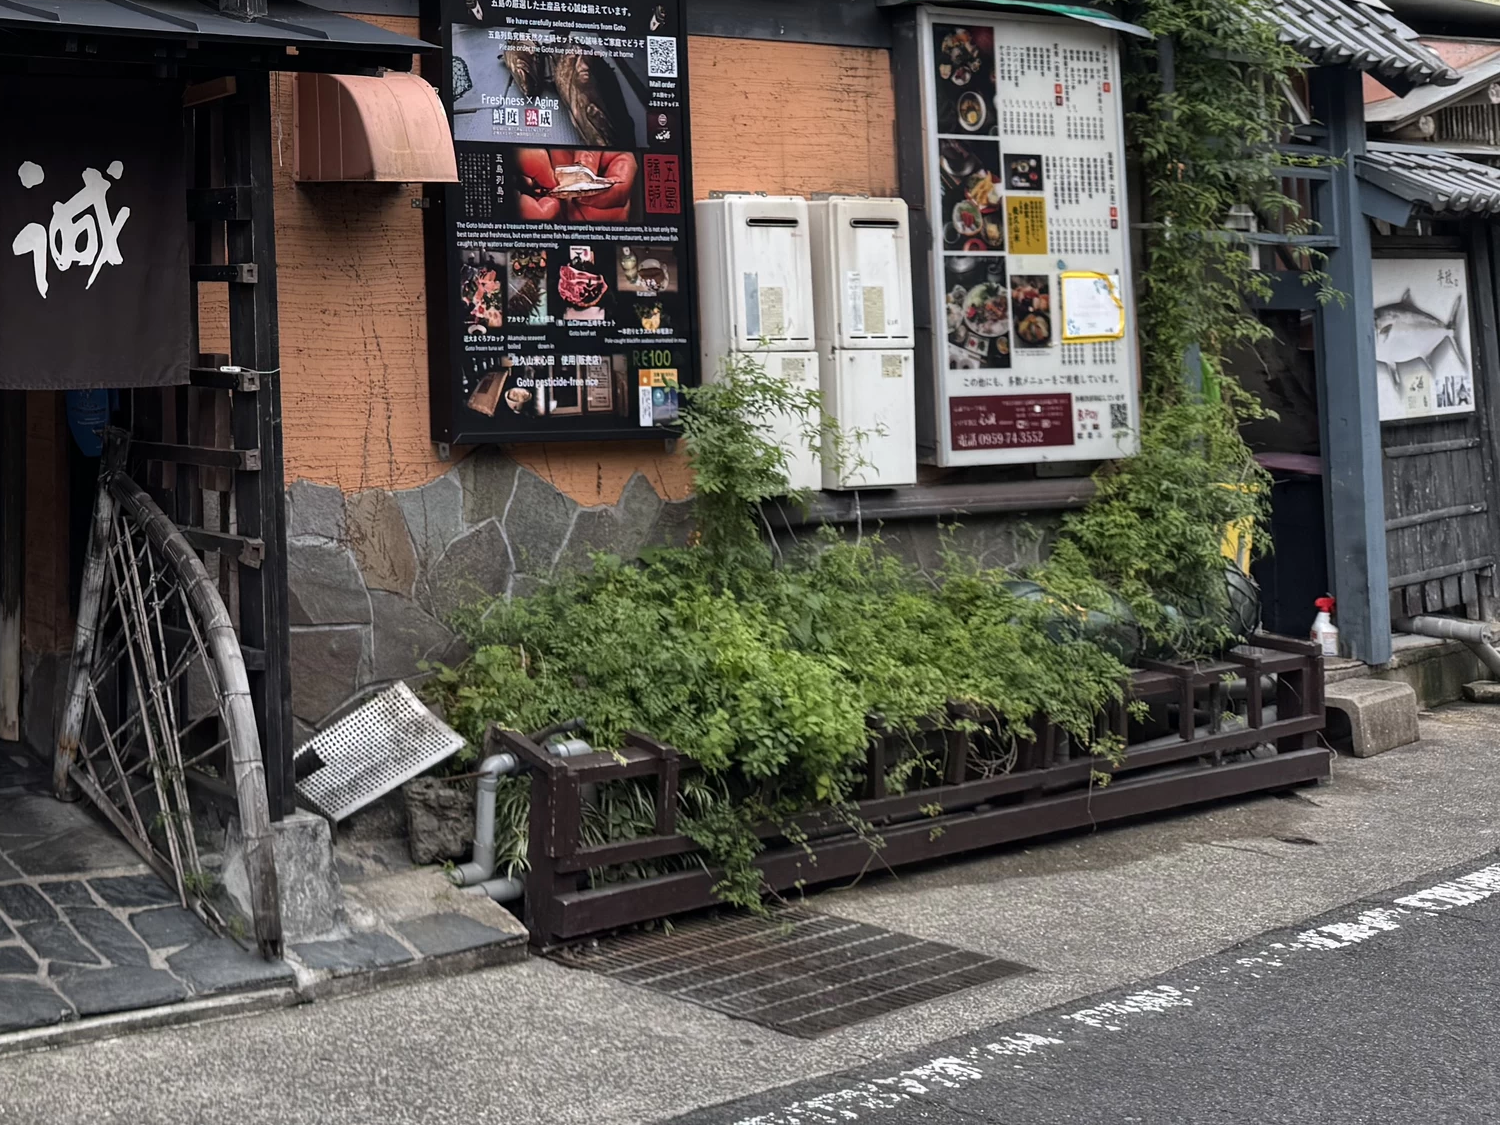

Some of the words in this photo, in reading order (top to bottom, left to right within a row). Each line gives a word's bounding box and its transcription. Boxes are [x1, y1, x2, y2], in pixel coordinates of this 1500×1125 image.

[481, 93, 524, 106] Freshness
[534, 96, 559, 110] Aging
[492, 108, 518, 125] 鮮度
[526, 110, 551, 126] 熟成
[517, 377, 534, 387] Goto
